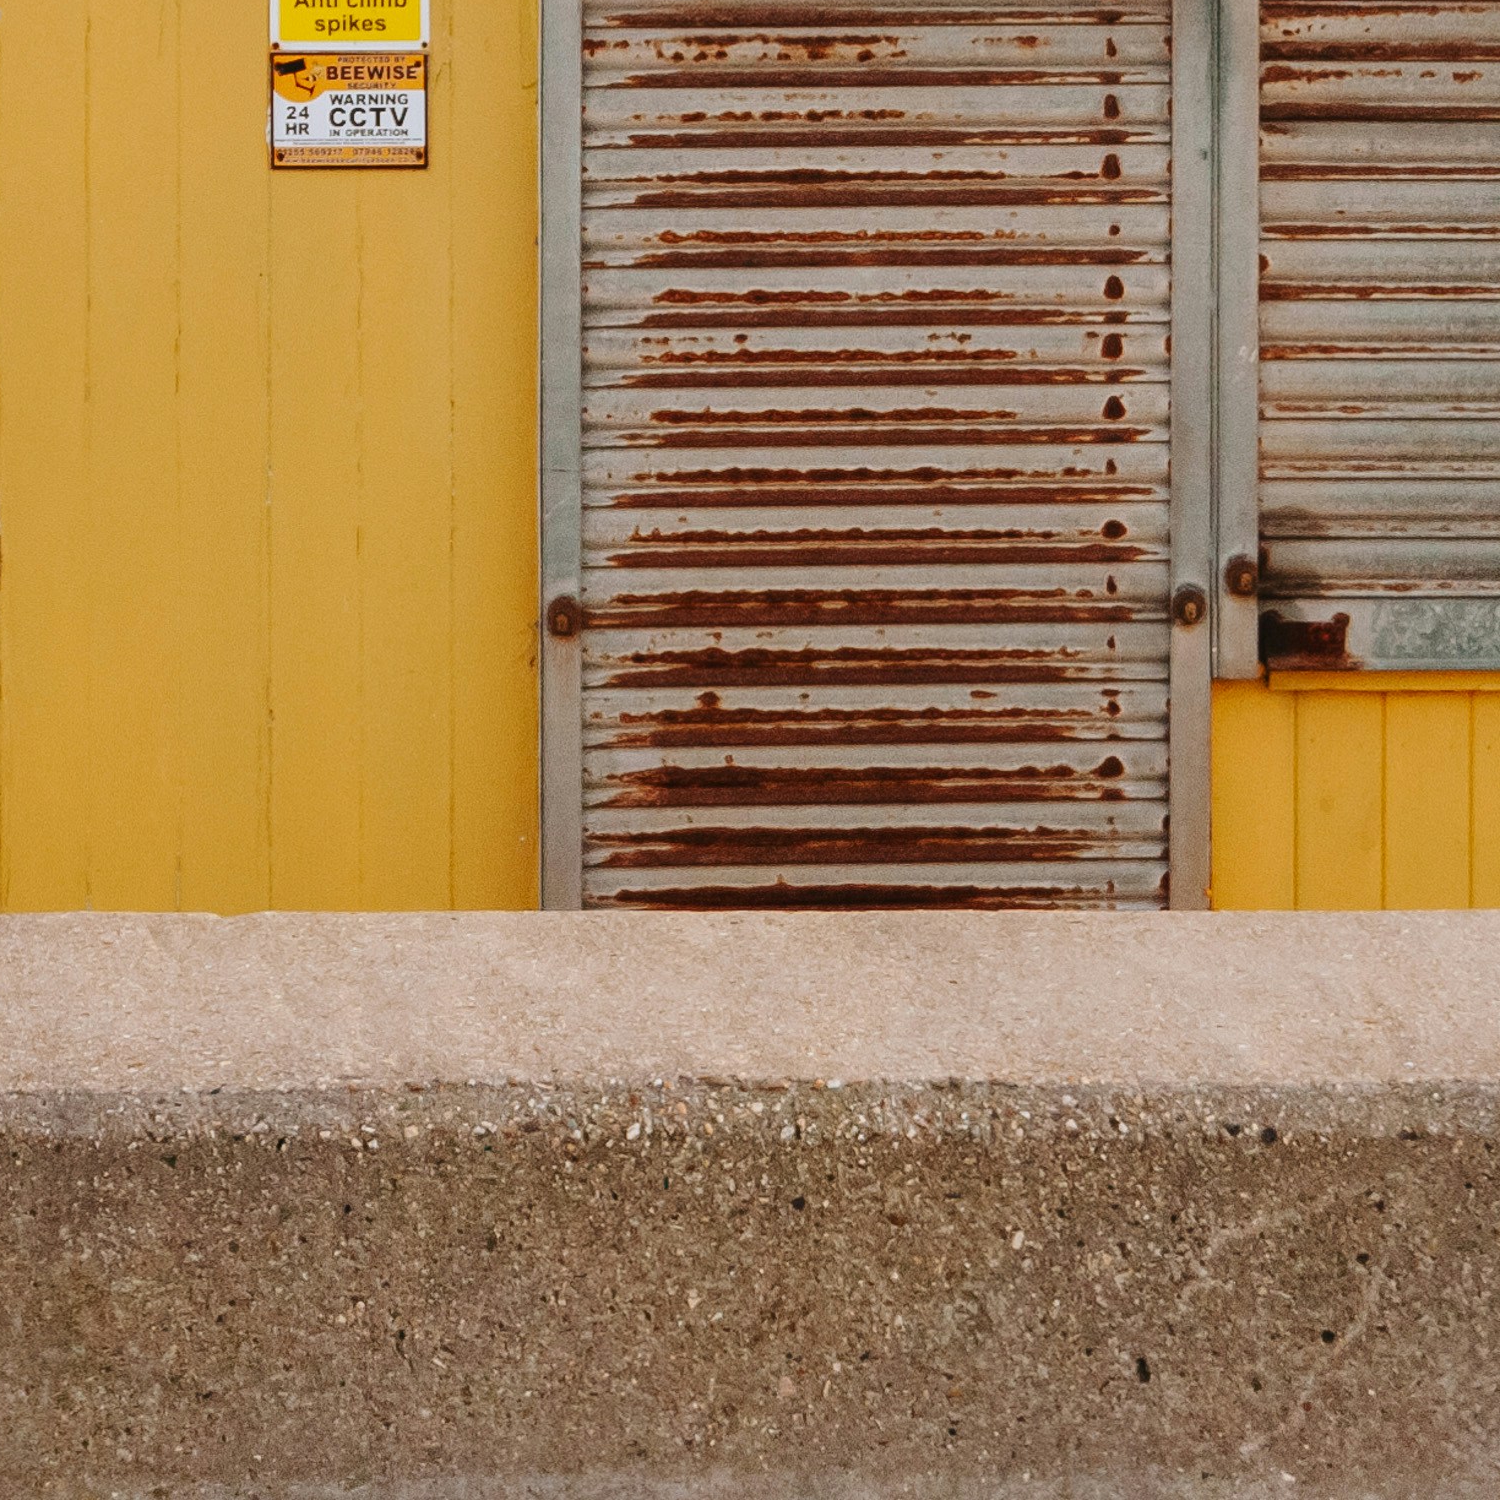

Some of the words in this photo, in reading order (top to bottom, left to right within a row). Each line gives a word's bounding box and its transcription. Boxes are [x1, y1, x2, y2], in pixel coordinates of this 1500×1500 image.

[314, 14, 387, 36] spikes
[337, 56, 389, 64] PROTECTED
[326, 65, 418, 80] BEEWISE
[329, 93, 409, 105] WARNING
[286, 106, 310, 120] 24
[329, 107, 409, 127] CCTV
[285, 122, 310, 136] HR
[329, 129, 341, 137] IN
[345, 129, 409, 137] OPERATION
